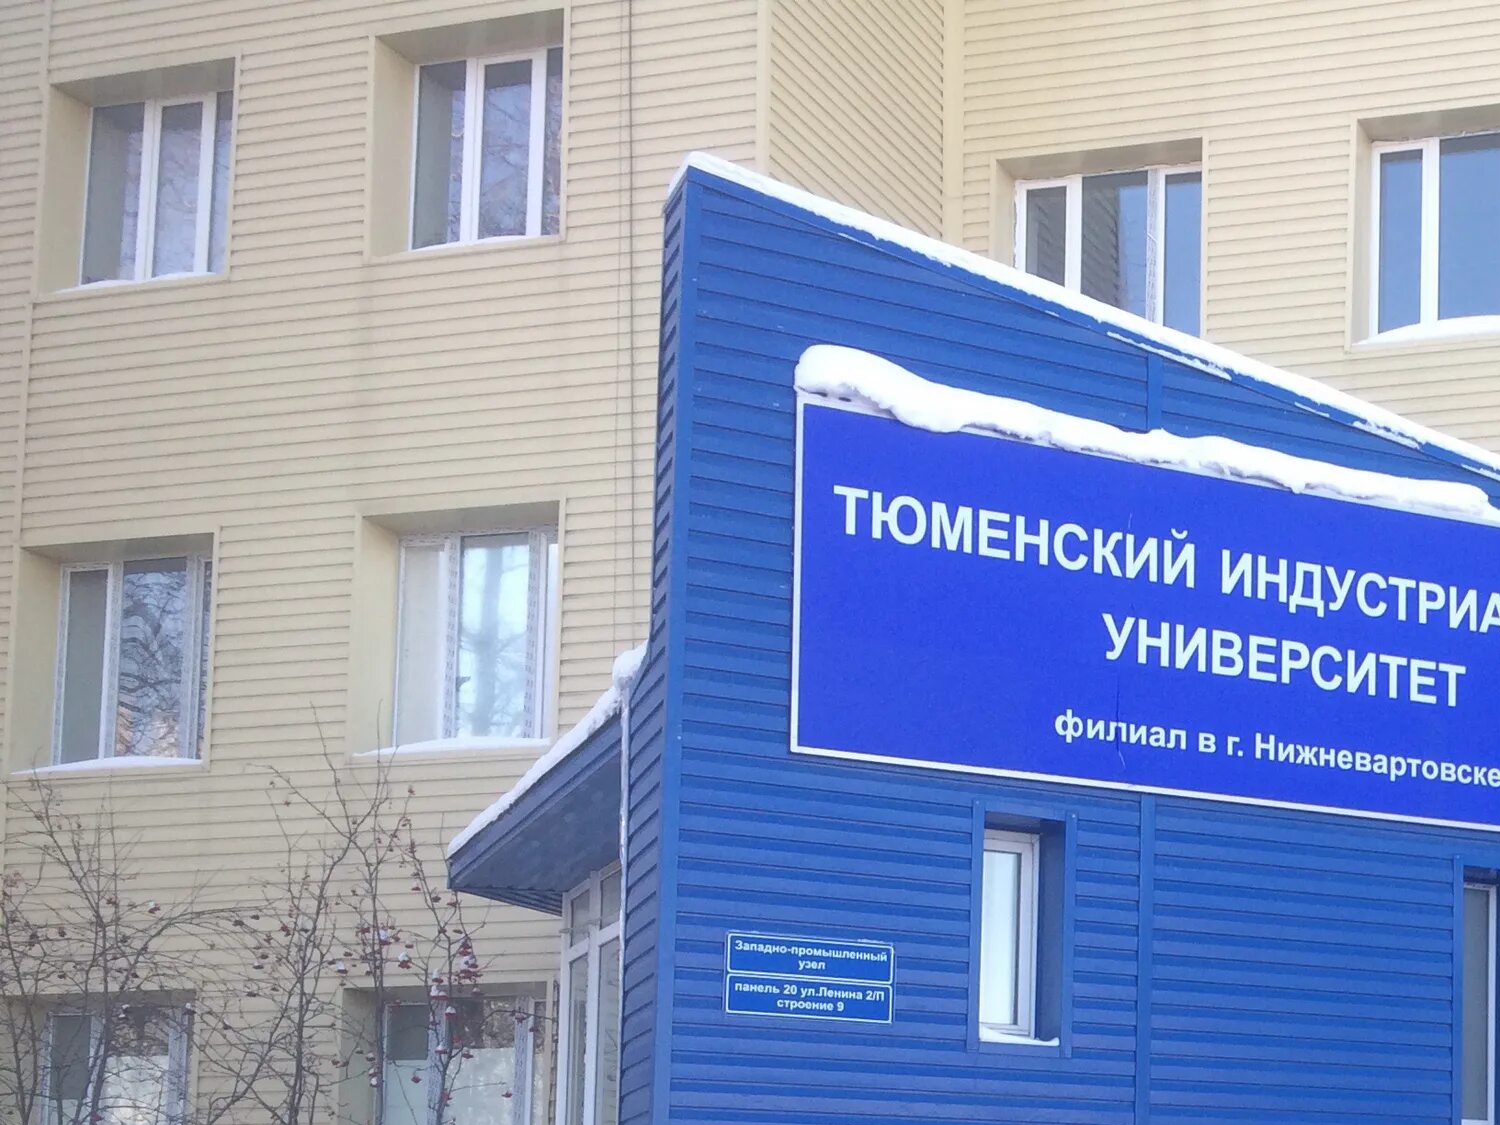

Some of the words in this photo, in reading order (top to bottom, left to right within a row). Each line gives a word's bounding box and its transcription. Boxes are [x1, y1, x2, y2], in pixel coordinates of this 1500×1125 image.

[833, 484, 1196, 589] ТЮМЕНСКИЙ
[1102, 613, 1467, 707] УНИВЕРСИТЕТ
[1053, 708, 1187, 751] филиал
[1198, 732, 1217, 754] в
[1227, 735, 1244, 758] г.
[735, 940, 887, 962] Западно-промышленный
[798, 959, 826, 970] узел
[735, 982, 779, 994] панель
[783, 984, 798, 995] 20
[865, 990, 885, 1001] 2/П
[777, 999, 834, 1011] строение
[836, 1001, 845, 1012] 9
